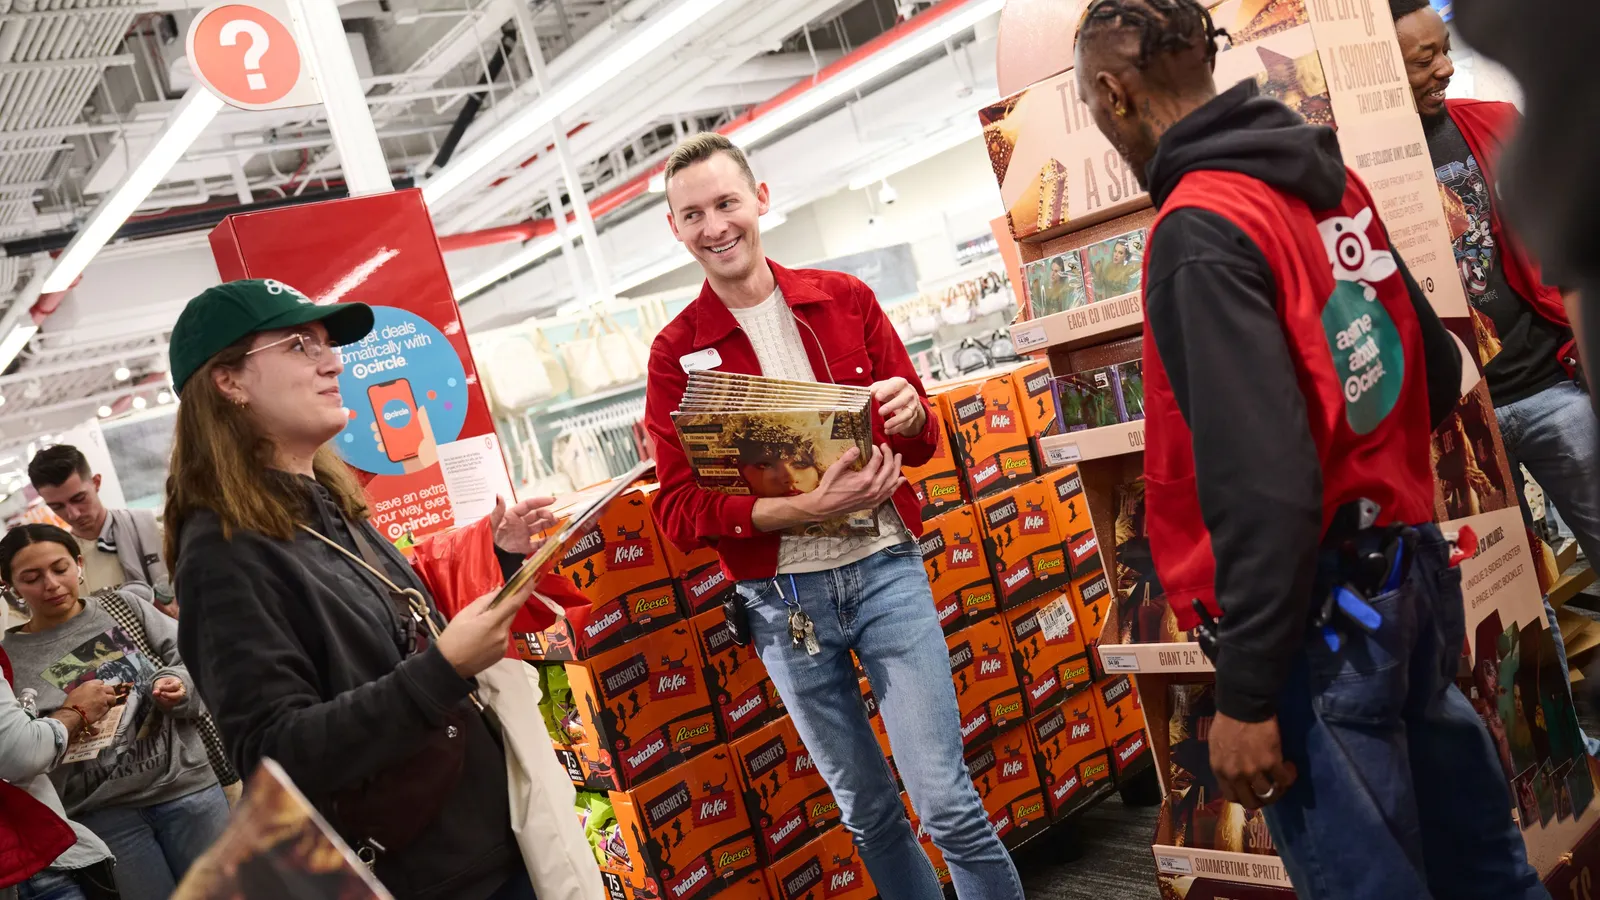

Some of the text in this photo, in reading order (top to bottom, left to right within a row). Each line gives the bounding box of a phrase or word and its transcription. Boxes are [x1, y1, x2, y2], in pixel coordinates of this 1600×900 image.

[1328, 40, 1400, 91] A SHOWGIRL
[1357, 87, 1405, 115] TAYLOR SWIFT
[1084, 148, 1142, 210] A SH
[1404, 170, 1424, 183] TAYLOR
[1404, 203, 1423, 216] POSTER
[1417, 252, 1436, 265] PHOTOS
[1067, 296, 1140, 331] EACH CD INCLUDES
[381, 321, 416, 341] deals
[340, 333, 432, 366] omatically with
[973, 464, 998, 484] Twizzlers
[1005, 458, 1028, 469] Reese's
[375, 482, 447, 513] save an extra
[931, 485, 956, 497] Reese's
[373, 510, 398, 528] your
[399, 503, 423, 520] way,
[989, 502, 1017, 524] HERSHEY'S
[1073, 537, 1097, 558] Twizzlers
[1037, 559, 1061, 571] Reese's
[1465, 569, 1486, 591] UNIQUE
[1502, 545, 1522, 563] POSTER
[691, 571, 725, 598] Twizzlers
[1004, 566, 1030, 588] Twizzlers
[1488, 577, 1502, 596] LYRIC
[1502, 564, 1524, 586] BOOKLET
[966, 593, 991, 607] Reese's
[1082, 578, 1107, 600] HERSHEY'S
[635, 595, 669, 613] Reese's
[939, 602, 958, 622] izzlers
[584, 609, 622, 638] Twizzlers
[1158, 651, 1182, 666] GIANT
[606, 661, 646, 691] HERSHEY'S
[1063, 666, 1086, 681] Reese's
[1031, 677, 1056, 700] Twizzlers
[1104, 679, 1130, 702] HERSHEY'S
[728, 694, 762, 721] Twizzlers
[995, 702, 1019, 717] Reese's
[676, 723, 710, 742] Reese's
[1038, 713, 1064, 738] HERSHEY'S
[562, 751, 577, 768] 75
[627, 739, 665, 769] Twizzlers
[750, 743, 784, 772] HERSHEY'S
[1119, 738, 1142, 761] Twizzlers
[1083, 763, 1105, 778] Reese's
[1053, 775, 1077, 800] Twizzlers
[650, 789, 688, 821] HERSHEY'S
[1017, 803, 1040, 818] Reese's
[770, 814, 802, 845] Twizzlers
[719, 847, 751, 868] Reese's
[672, 865, 708, 897] Twizzlers
[787, 863, 821, 895] HERSHEY'S
[1195, 857, 1250, 878] SUMMERTIME
[1252, 863, 1282, 882] SPRITZ
[605, 873, 620, 891] 75
